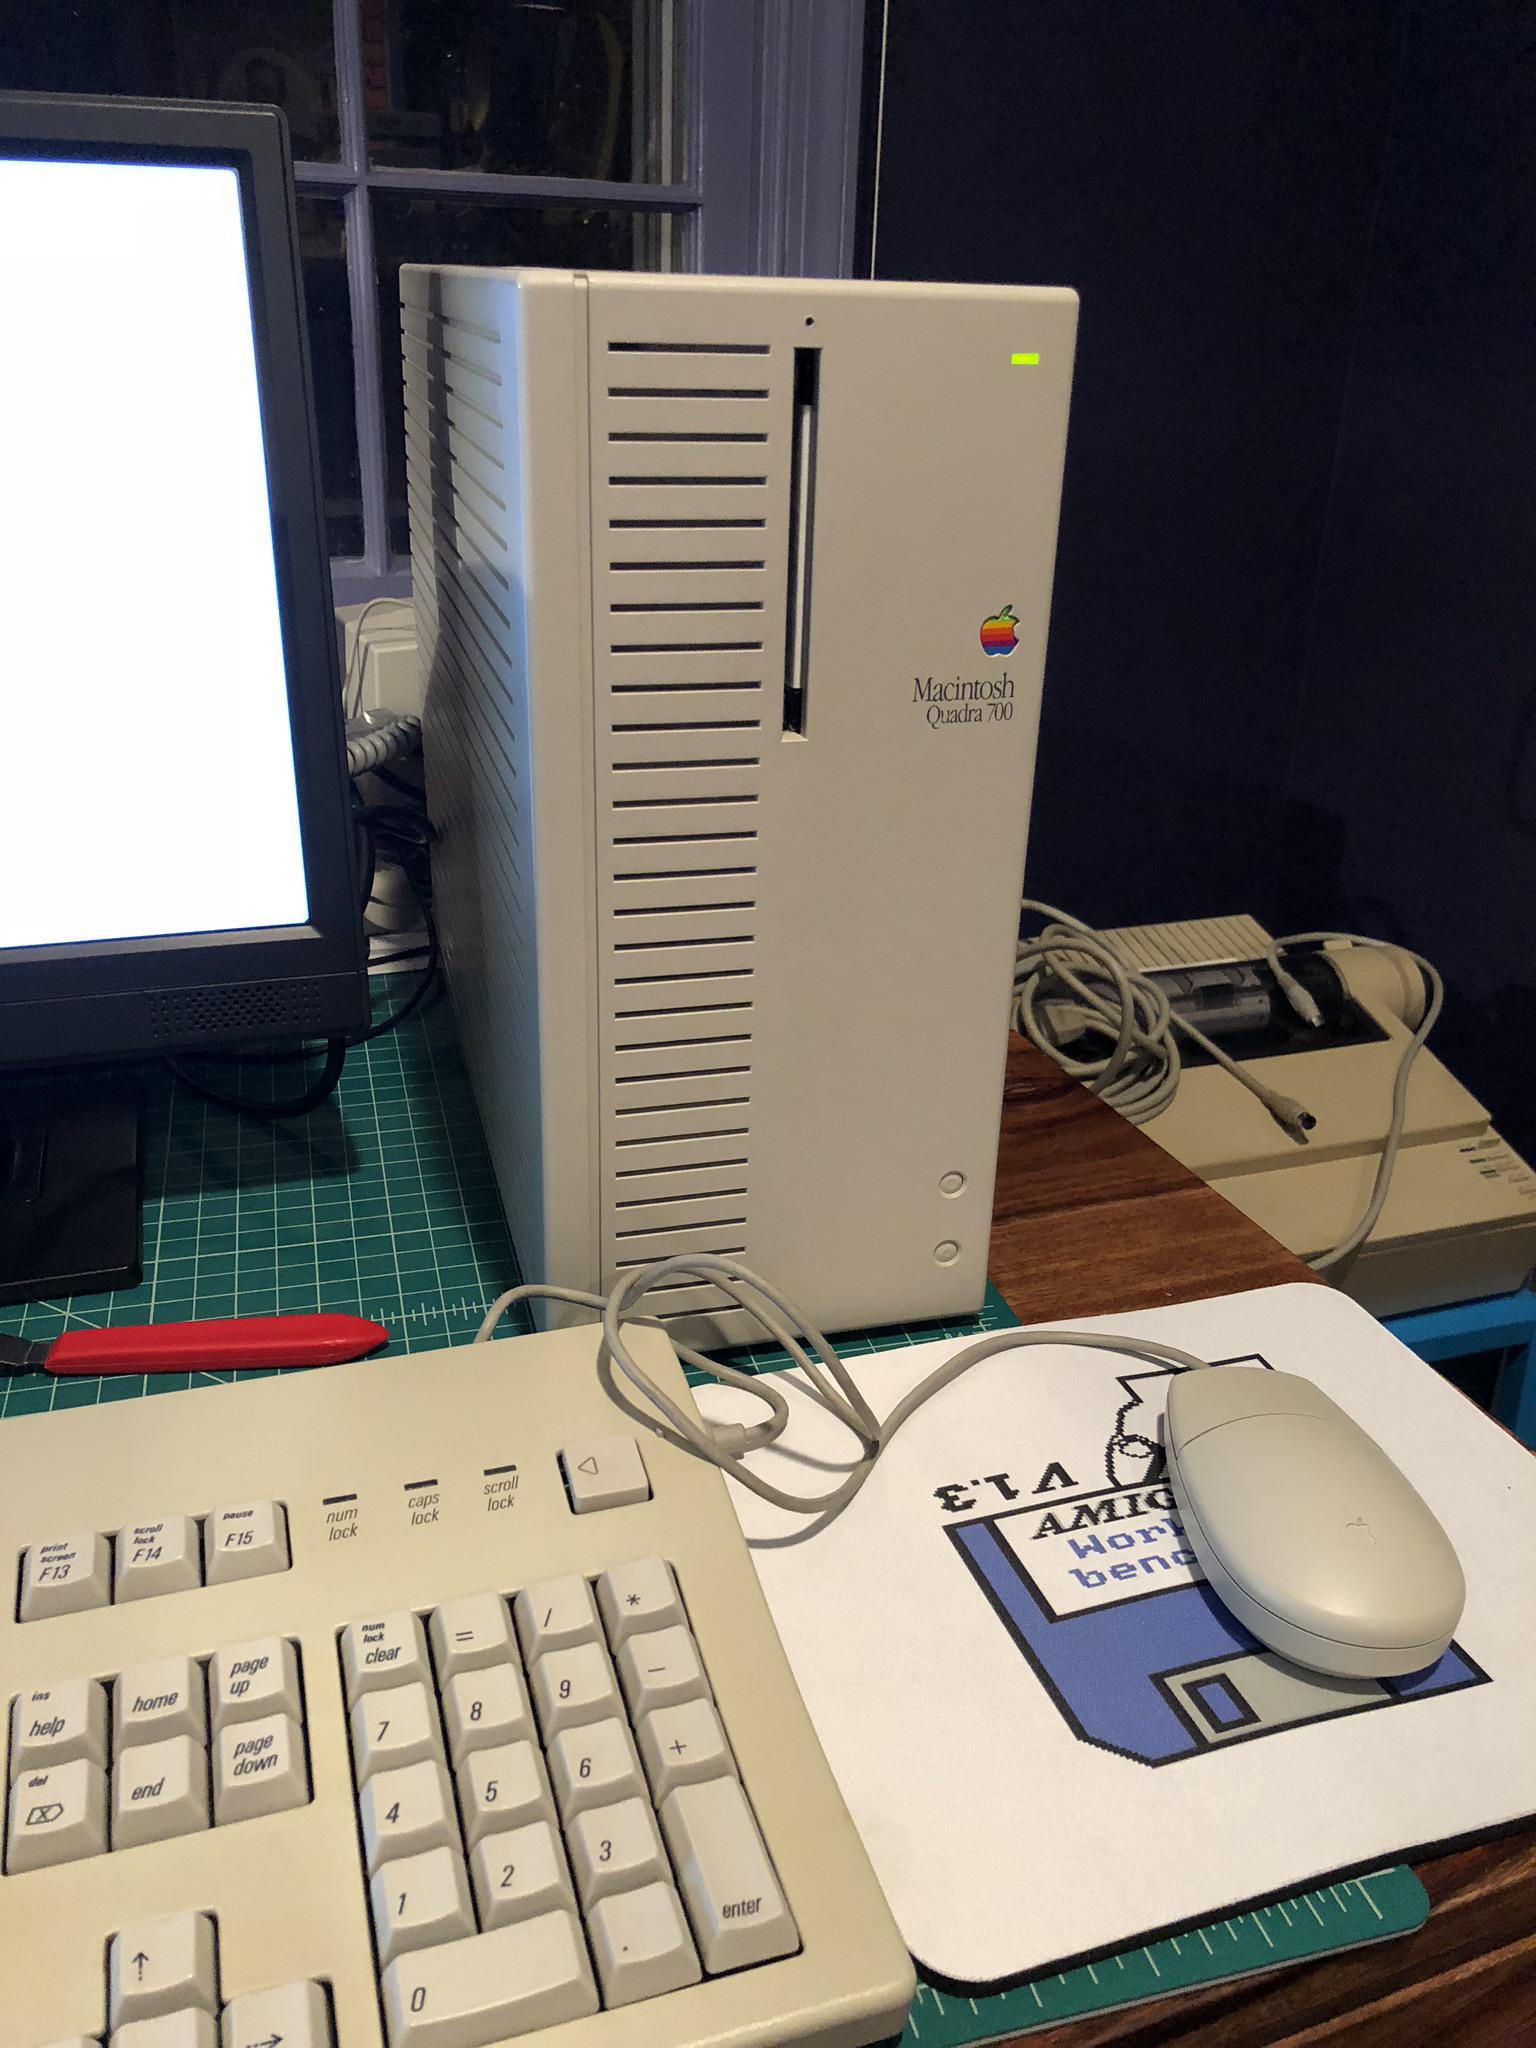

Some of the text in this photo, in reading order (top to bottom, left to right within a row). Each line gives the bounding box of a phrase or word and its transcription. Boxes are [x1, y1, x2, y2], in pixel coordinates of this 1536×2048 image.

[912, 671, 1015, 703] Macintosh
[926, 701, 1014, 730] Quadra 700
[484, 1475, 519, 1496] scroll
[407, 1492, 440, 1511] caps
[487, 1494, 515, 1512] lock
[222, 1510, 254, 1521] pause
[326, 1508, 358, 1524] num
[411, 1508, 440, 1526] lock
[1031, 1487, 1177, 1540] AMIG
[133, 1523, 164, 1535] scroll
[224, 1530, 254, 1547] F15
[328, 1523, 358, 1542] lock
[39, 1542, 69, 1555] print
[133, 1535, 156, 1545] lock
[39, 1550, 77, 1564] screen
[132, 1546, 163, 1563] F14
[38, 1564, 71, 1582] F13
[1067, 1547, 1198, 1590] benc
[361, 1622, 386, 1632] num
[363, 1631, 385, 1644] lock
[365, 1646, 402, 1665] clear
[229, 1656, 269, 1679] page
[31, 1691, 51, 1702] ins
[229, 1679, 251, 1698] up
[558, 1679, 571, 1699] 9
[131, 1692, 179, 1713] home
[469, 1701, 483, 1722] 8
[28, 1716, 66, 1738] help
[377, 1720, 390, 1742] 7
[233, 1734, 274, 1759] page
[232, 1753, 279, 1777] down
[579, 1757, 592, 1779] 6
[27, 1775, 49, 1788] del
[130, 1776, 166, 1801] end
[484, 1780, 498, 1803] 5
[384, 1802, 400, 1824] 4
[599, 1840, 612, 1862] 3
[500, 1864, 515, 1888] 2
[398, 1892, 407, 1916] 1
[722, 1897, 762, 1919] enter
[410, 1986, 427, 2013] 0
